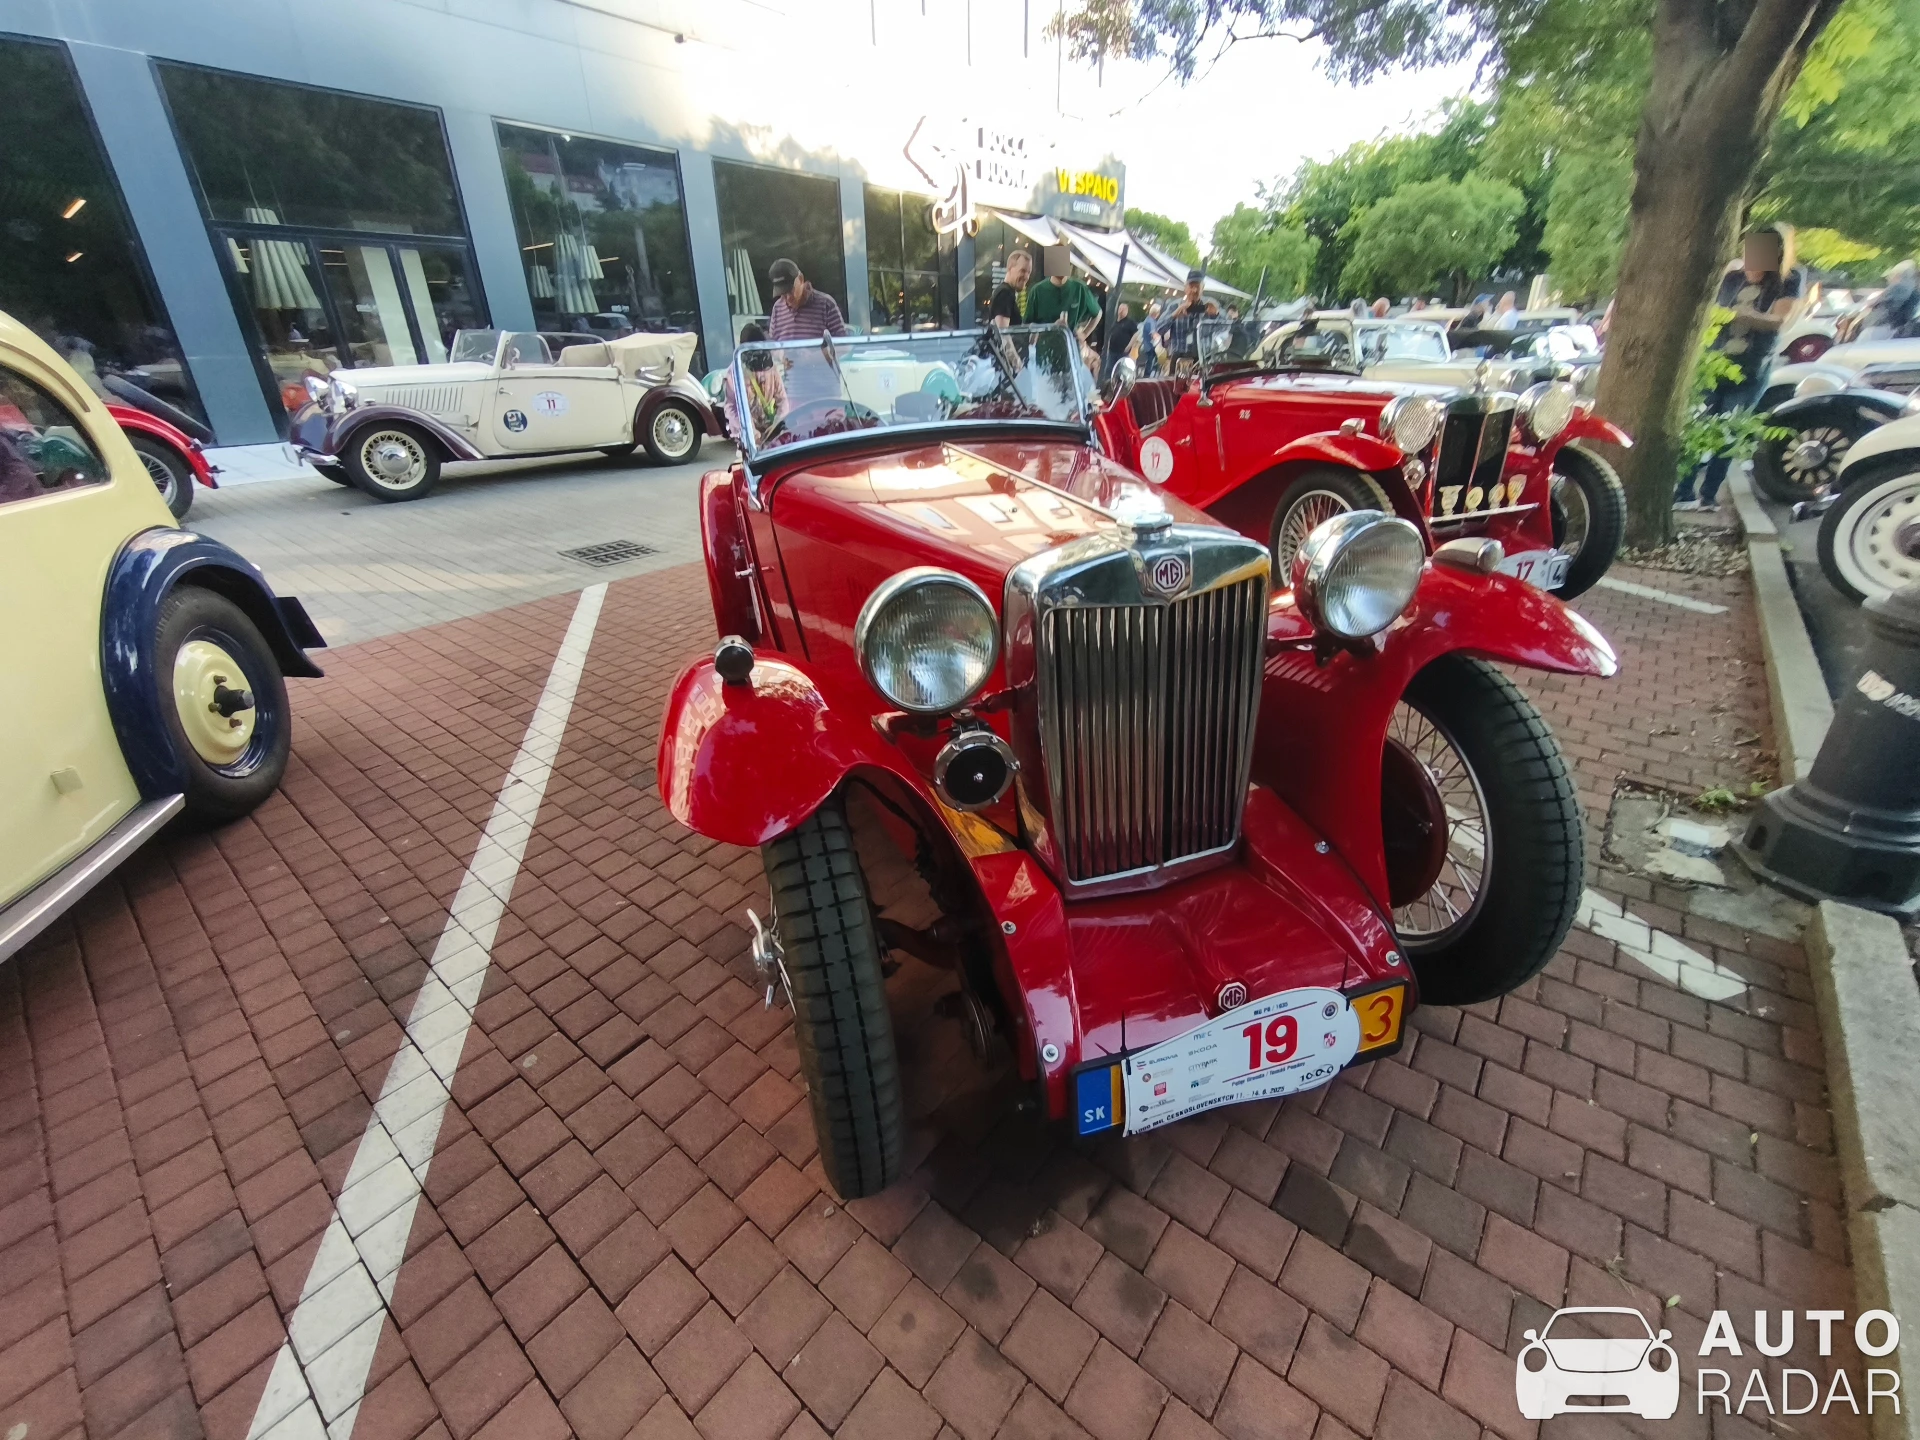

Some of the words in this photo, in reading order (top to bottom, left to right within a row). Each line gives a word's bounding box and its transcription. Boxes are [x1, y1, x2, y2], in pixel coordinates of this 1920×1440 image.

[547, 399, 556, 410] 11
[1152, 452, 1161, 469] 17
[1160, 563, 1179, 585] MG
[1516, 561, 1535, 581] 17
[1365, 996, 1394, 1042] 3
[1243, 1015, 1298, 1070] 19
[1084, 1105, 1105, 1123] SK
